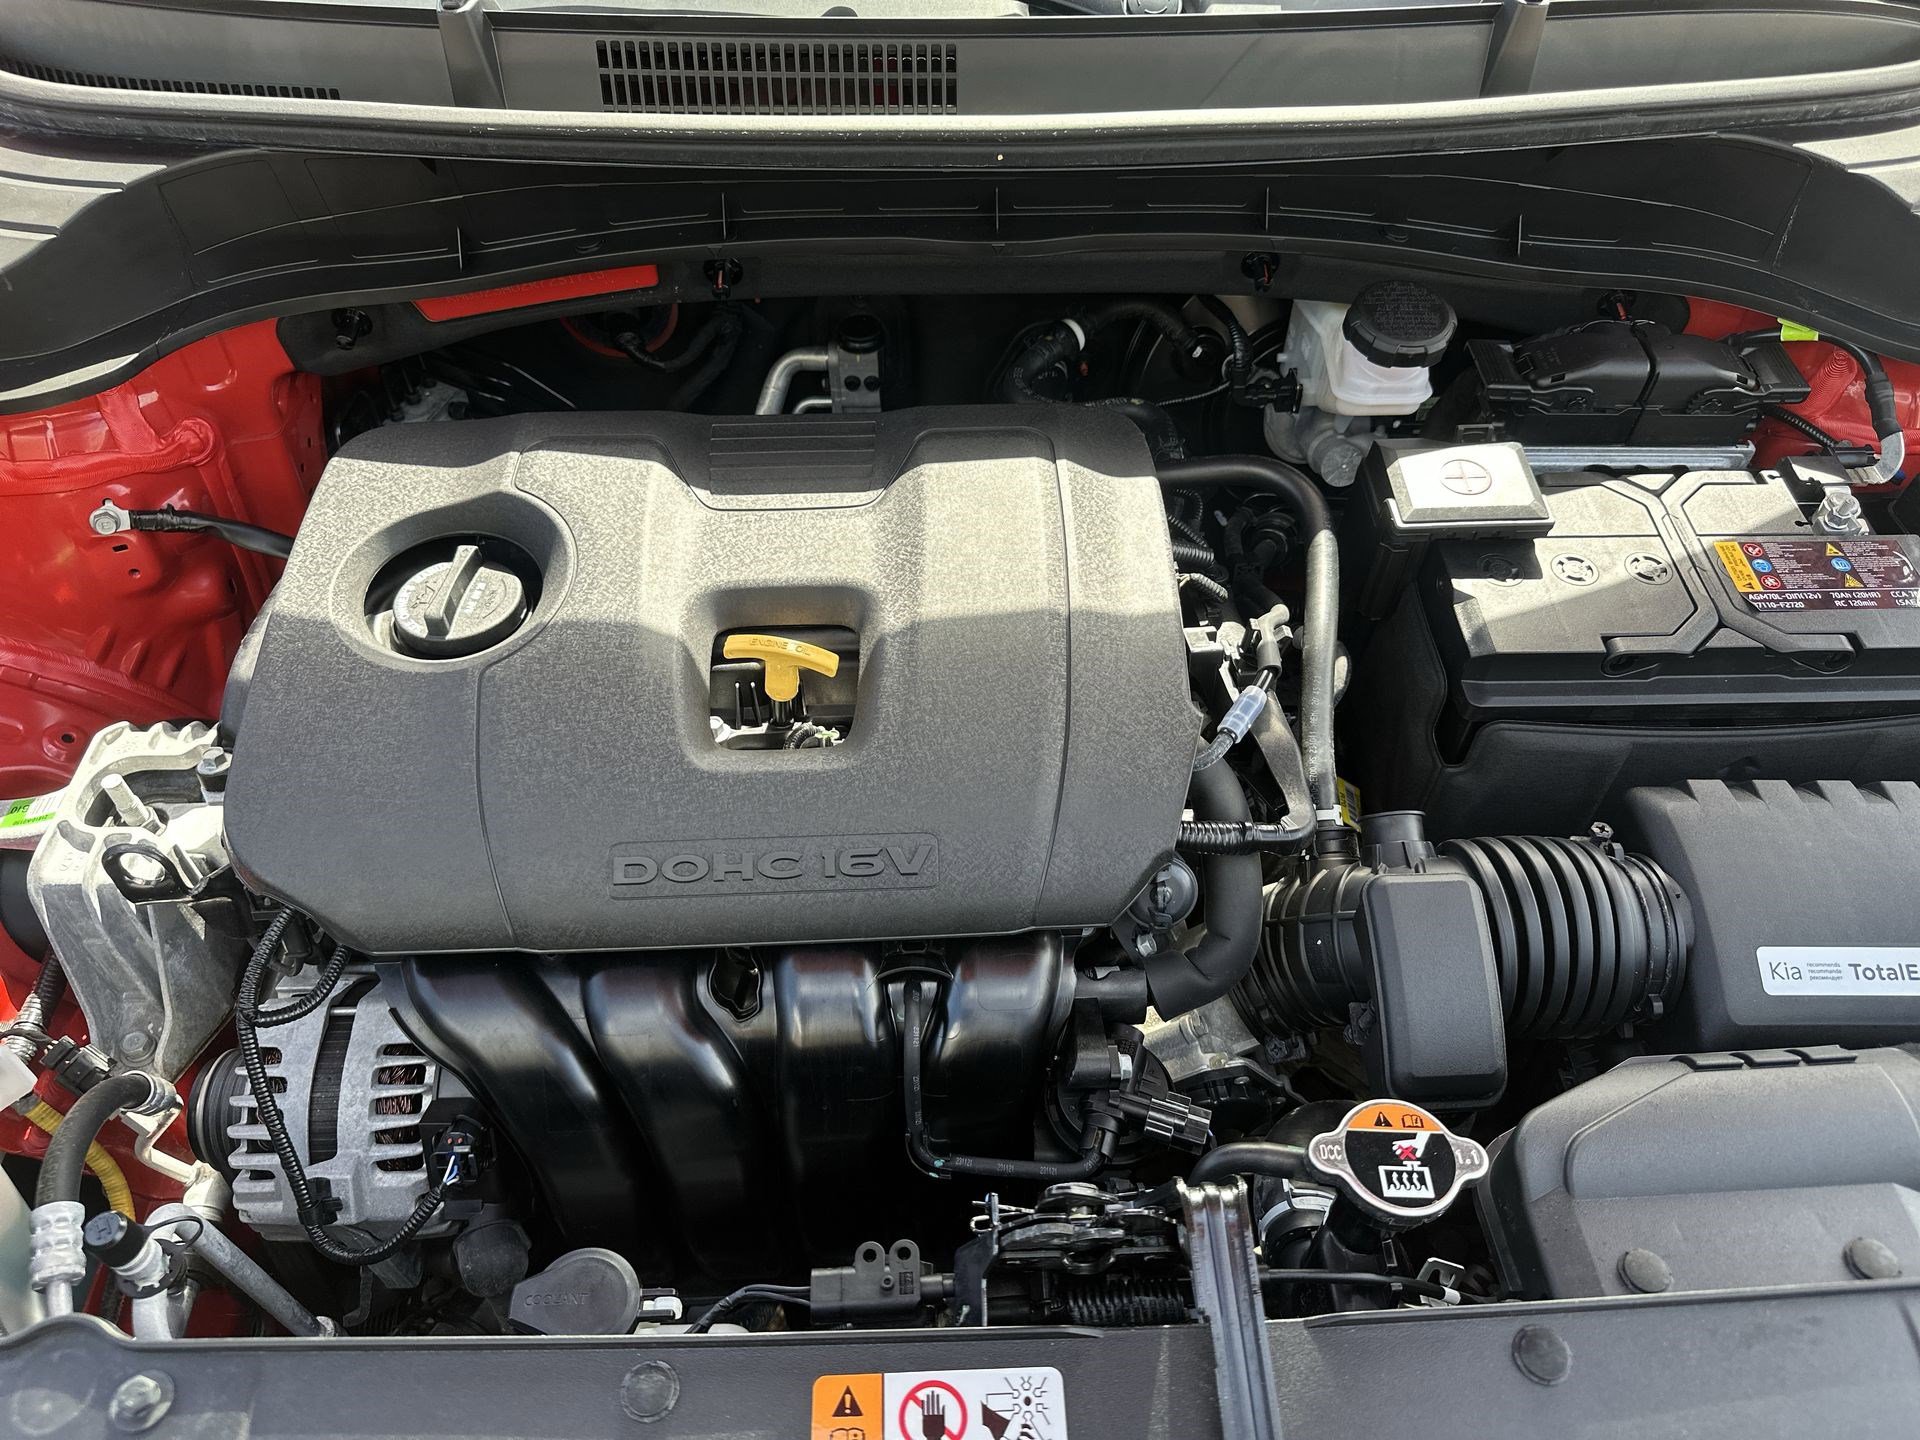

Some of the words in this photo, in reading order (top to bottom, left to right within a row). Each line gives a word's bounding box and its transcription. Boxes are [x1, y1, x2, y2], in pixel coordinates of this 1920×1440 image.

[1852, 591, 1881, 599] (20HR)
[1890, 590, 1908, 598] CCA
[1848, 599, 1878, 607] 120min
[749, 638, 788, 650] ENGINE
[795, 645, 811, 657] OIL
[612, 850, 804, 886] DOHC
[821, 845, 934, 879] 16V
[1768, 961, 1803, 980] Kia
[1848, 962, 1920, 981] TotalE
[1319, 1144, 1342, 1161] DCC
[1455, 1149, 1480, 1165] 1.1
[955, 1156, 973, 1167] 231121
[524, 1291, 590, 1306] COOLANT
